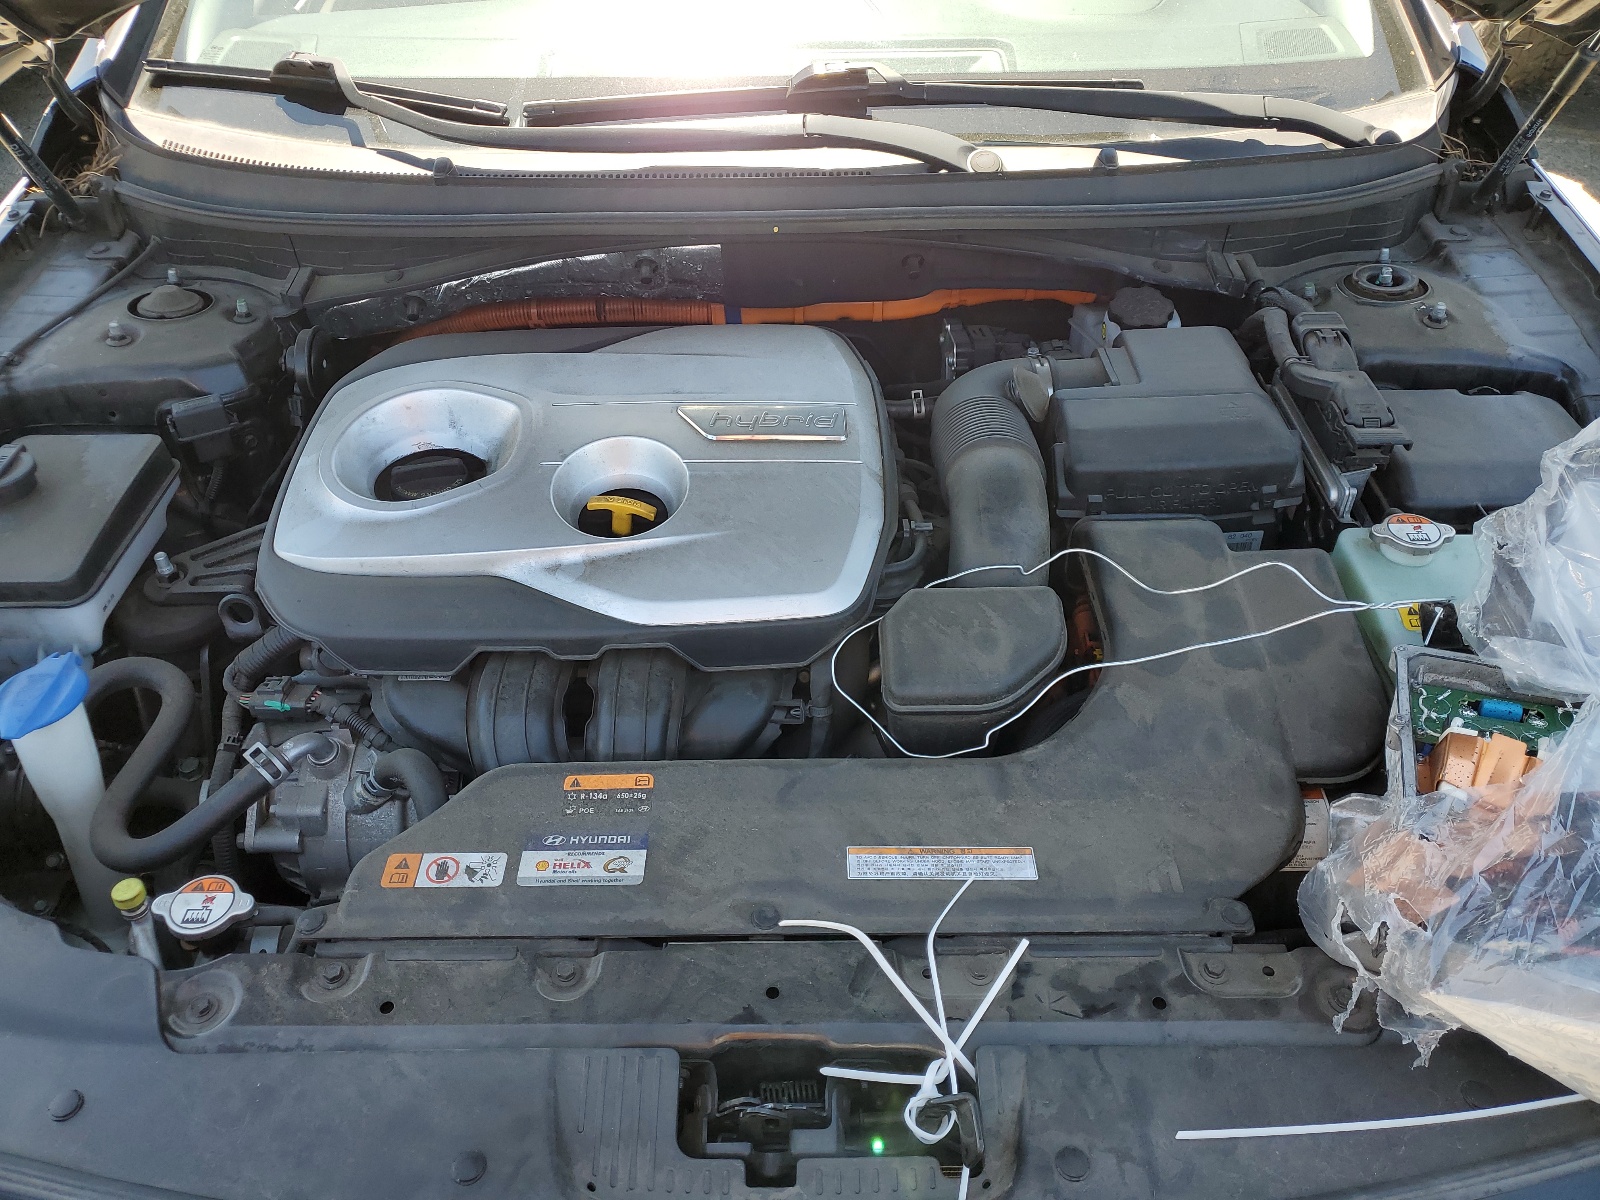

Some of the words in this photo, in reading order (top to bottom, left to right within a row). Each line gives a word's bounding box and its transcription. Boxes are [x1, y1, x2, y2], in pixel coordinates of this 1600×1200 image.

[709, 410, 839, 431] hybrid
[580, 792, 608, 801] R-134a
[569, 835, 631, 844] HYUNDAI
[552, 860, 593, 870] HELIX
